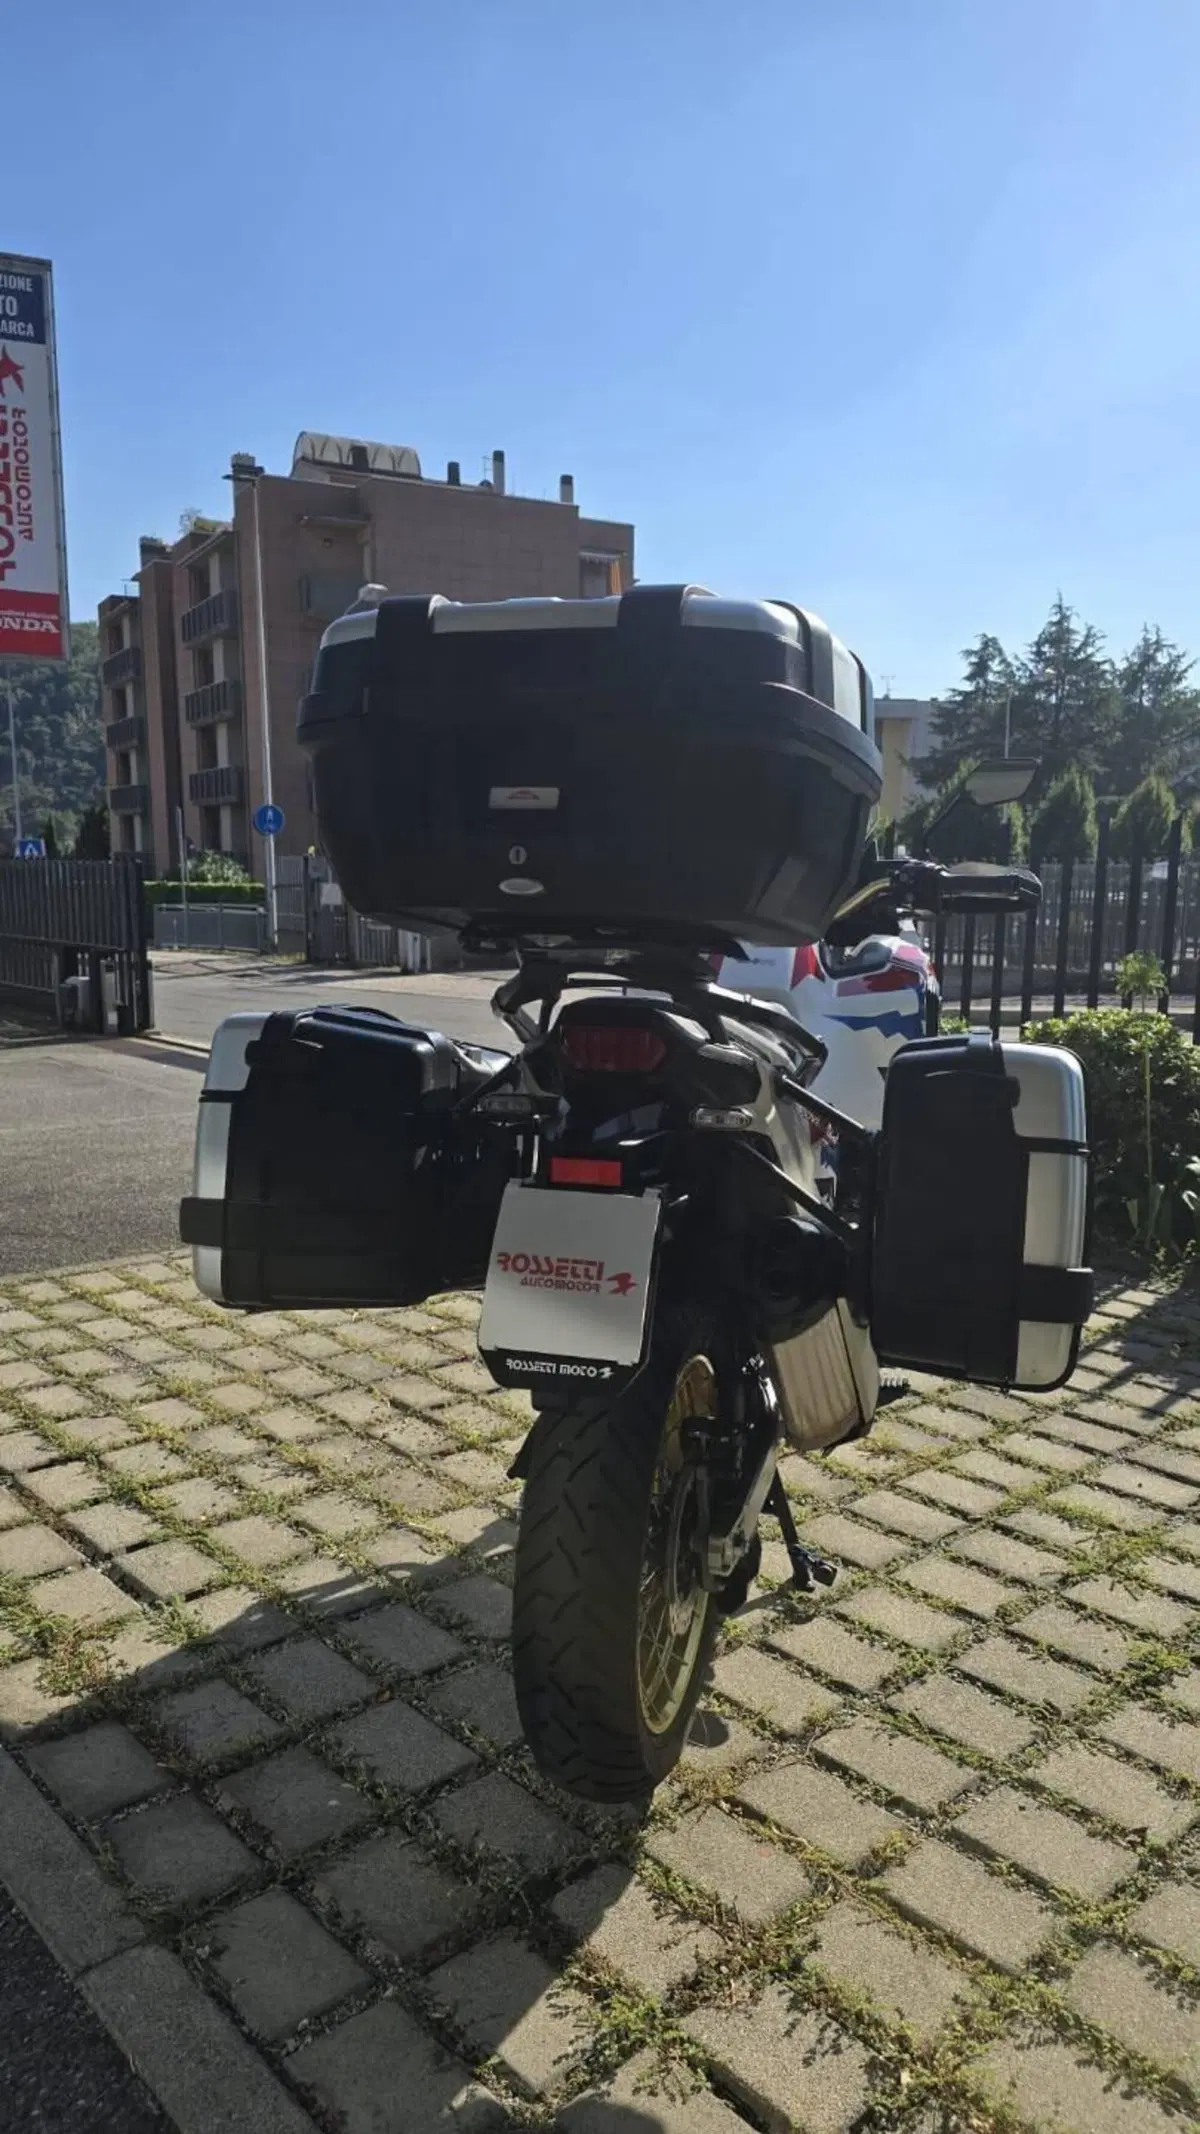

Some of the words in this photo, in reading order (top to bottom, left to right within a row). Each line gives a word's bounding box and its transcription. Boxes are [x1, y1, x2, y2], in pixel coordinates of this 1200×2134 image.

[12, 407, 33, 541] AUTOMOTOR
[0, 617, 60, 634] NDA
[496, 1252, 605, 1281] ROSSETTI
[520, 1276, 602, 1293] AUTOMOTOR
[506, 1358, 557, 1374] ROSSETTI
[559, 1364, 598, 1378] MOTO
